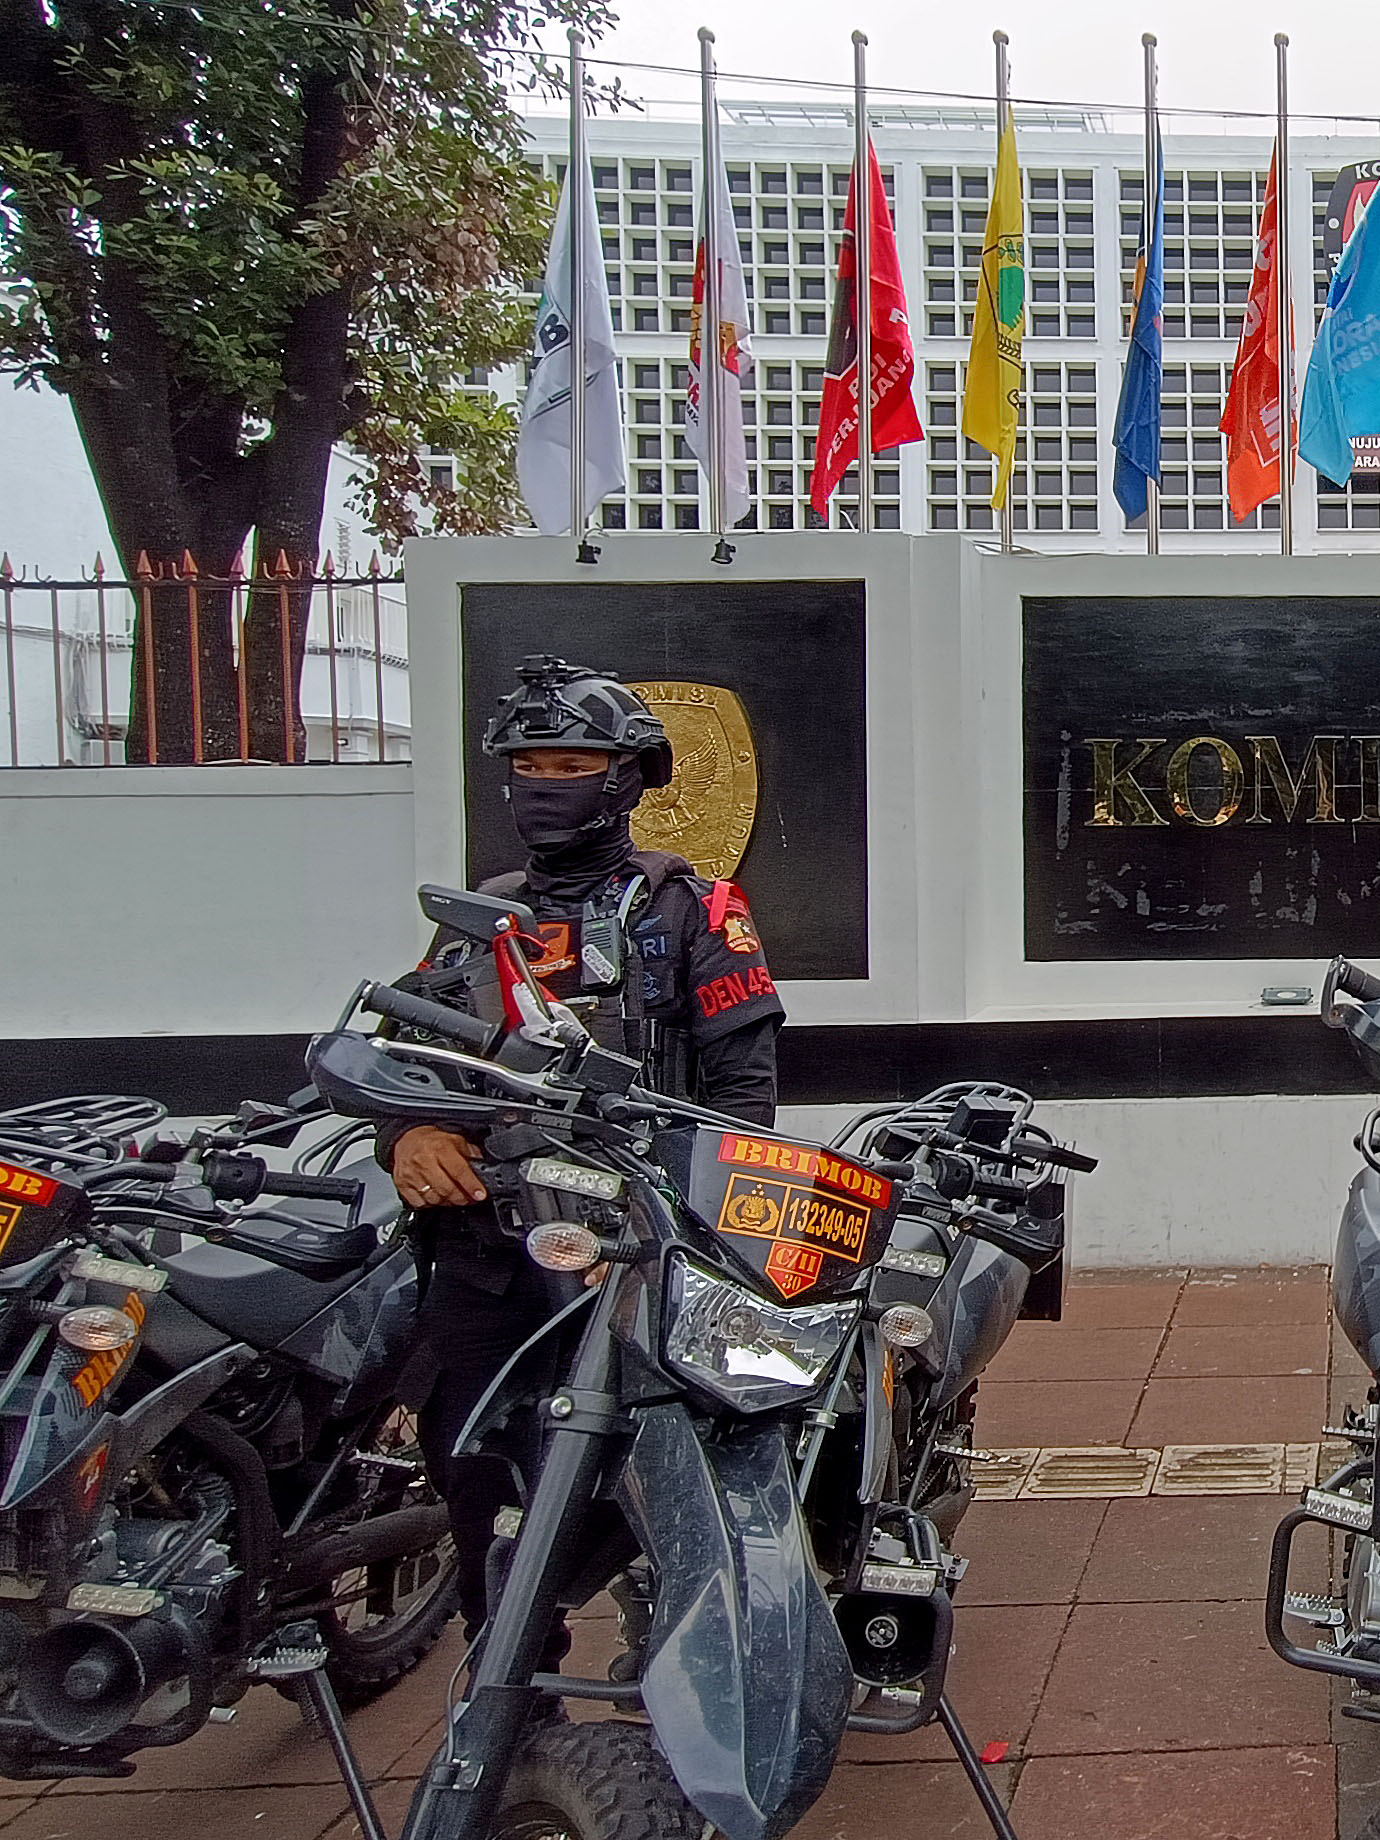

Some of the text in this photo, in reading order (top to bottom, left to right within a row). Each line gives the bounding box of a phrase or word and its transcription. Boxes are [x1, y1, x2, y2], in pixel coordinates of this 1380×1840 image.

[1349, 437, 1380, 449] NUJU
[1354, 455, 1380, 468] ARA
[696, 971, 750, 1018] DEN
[731, 1139, 883, 1200] BRIMOB
[788, 1197, 864, 1249] 132349-05
[782, 1274, 802, 1291] 30
